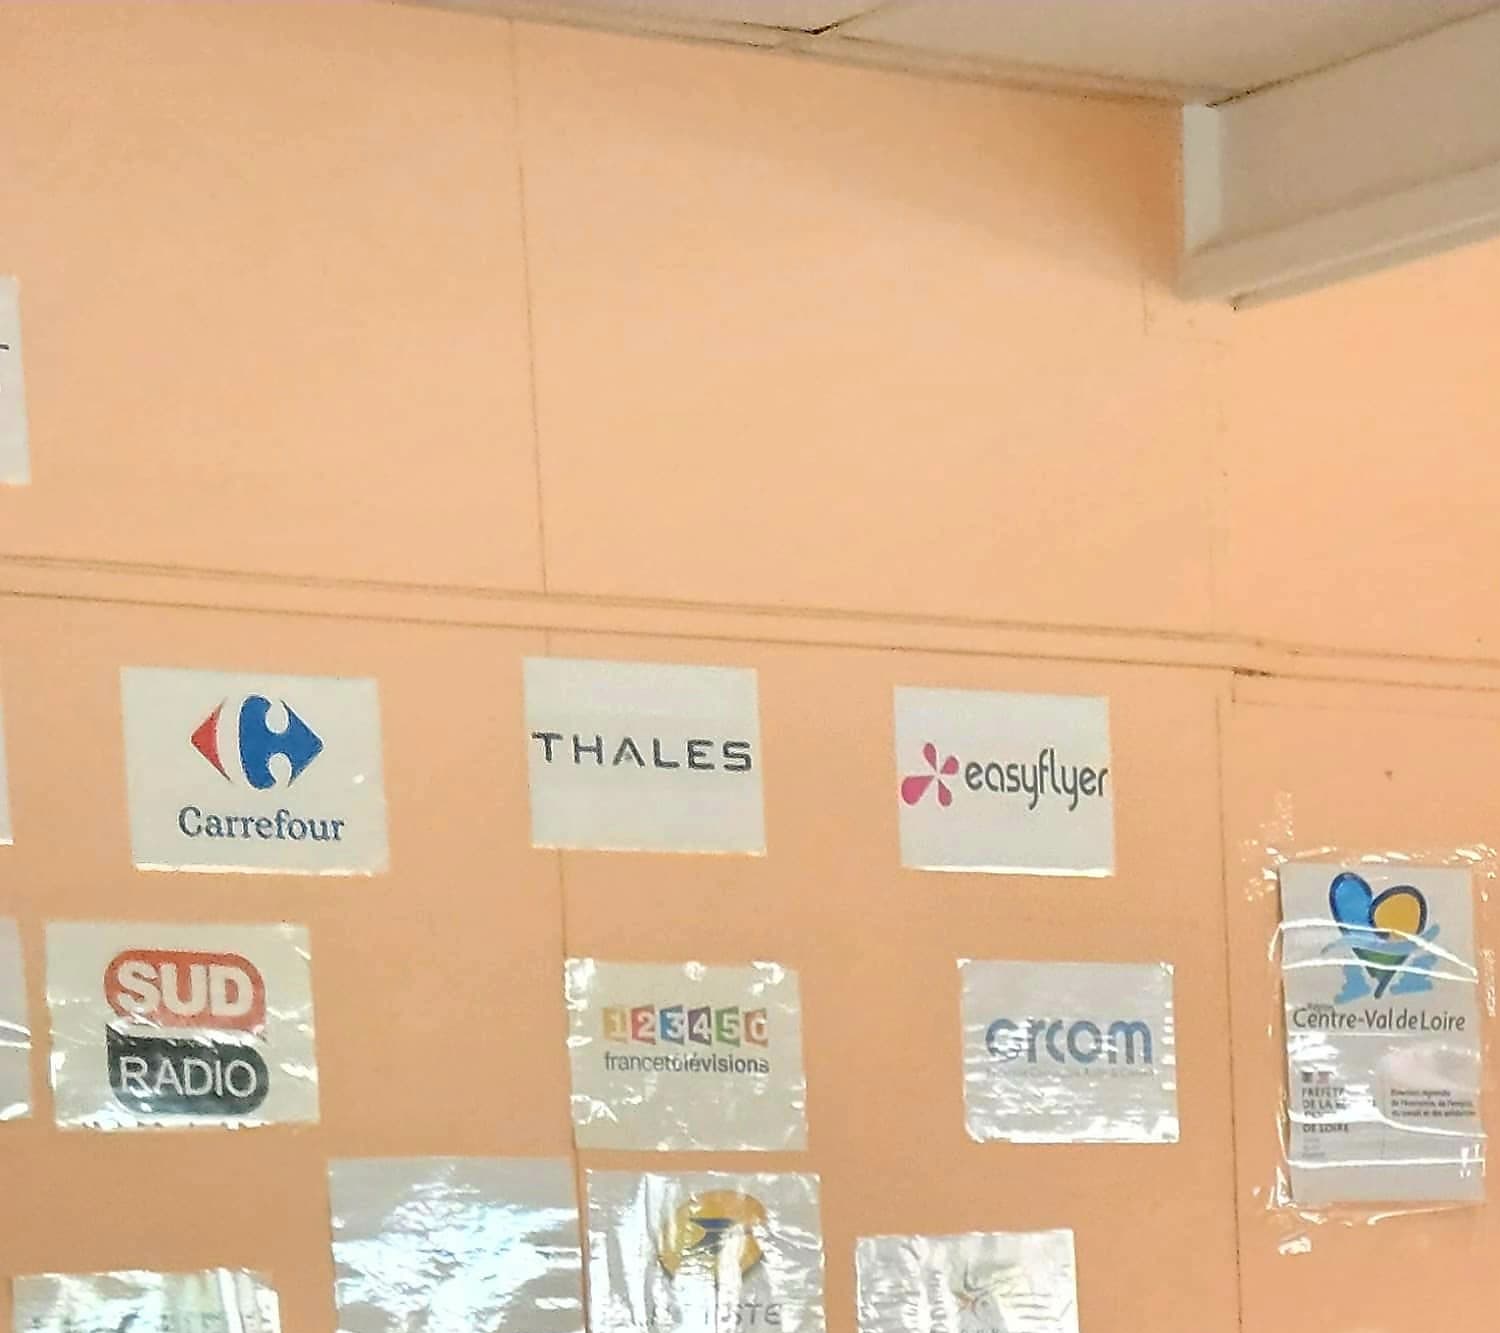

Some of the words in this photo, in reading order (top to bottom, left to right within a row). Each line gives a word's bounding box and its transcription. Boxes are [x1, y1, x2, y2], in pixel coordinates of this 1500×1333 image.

[531, 731, 753, 771] THALES
[965, 748, 1108, 812] easyflyer
[178, 805, 345, 842] Carrefour
[116, 959, 253, 1017] SUD
[1292, 1007, 1393, 1031] Centre-Val
[1396, 1008, 1418, 1031] de
[1420, 1009, 1466, 1032] Loire
[119, 1055, 258, 1099] RADIO
